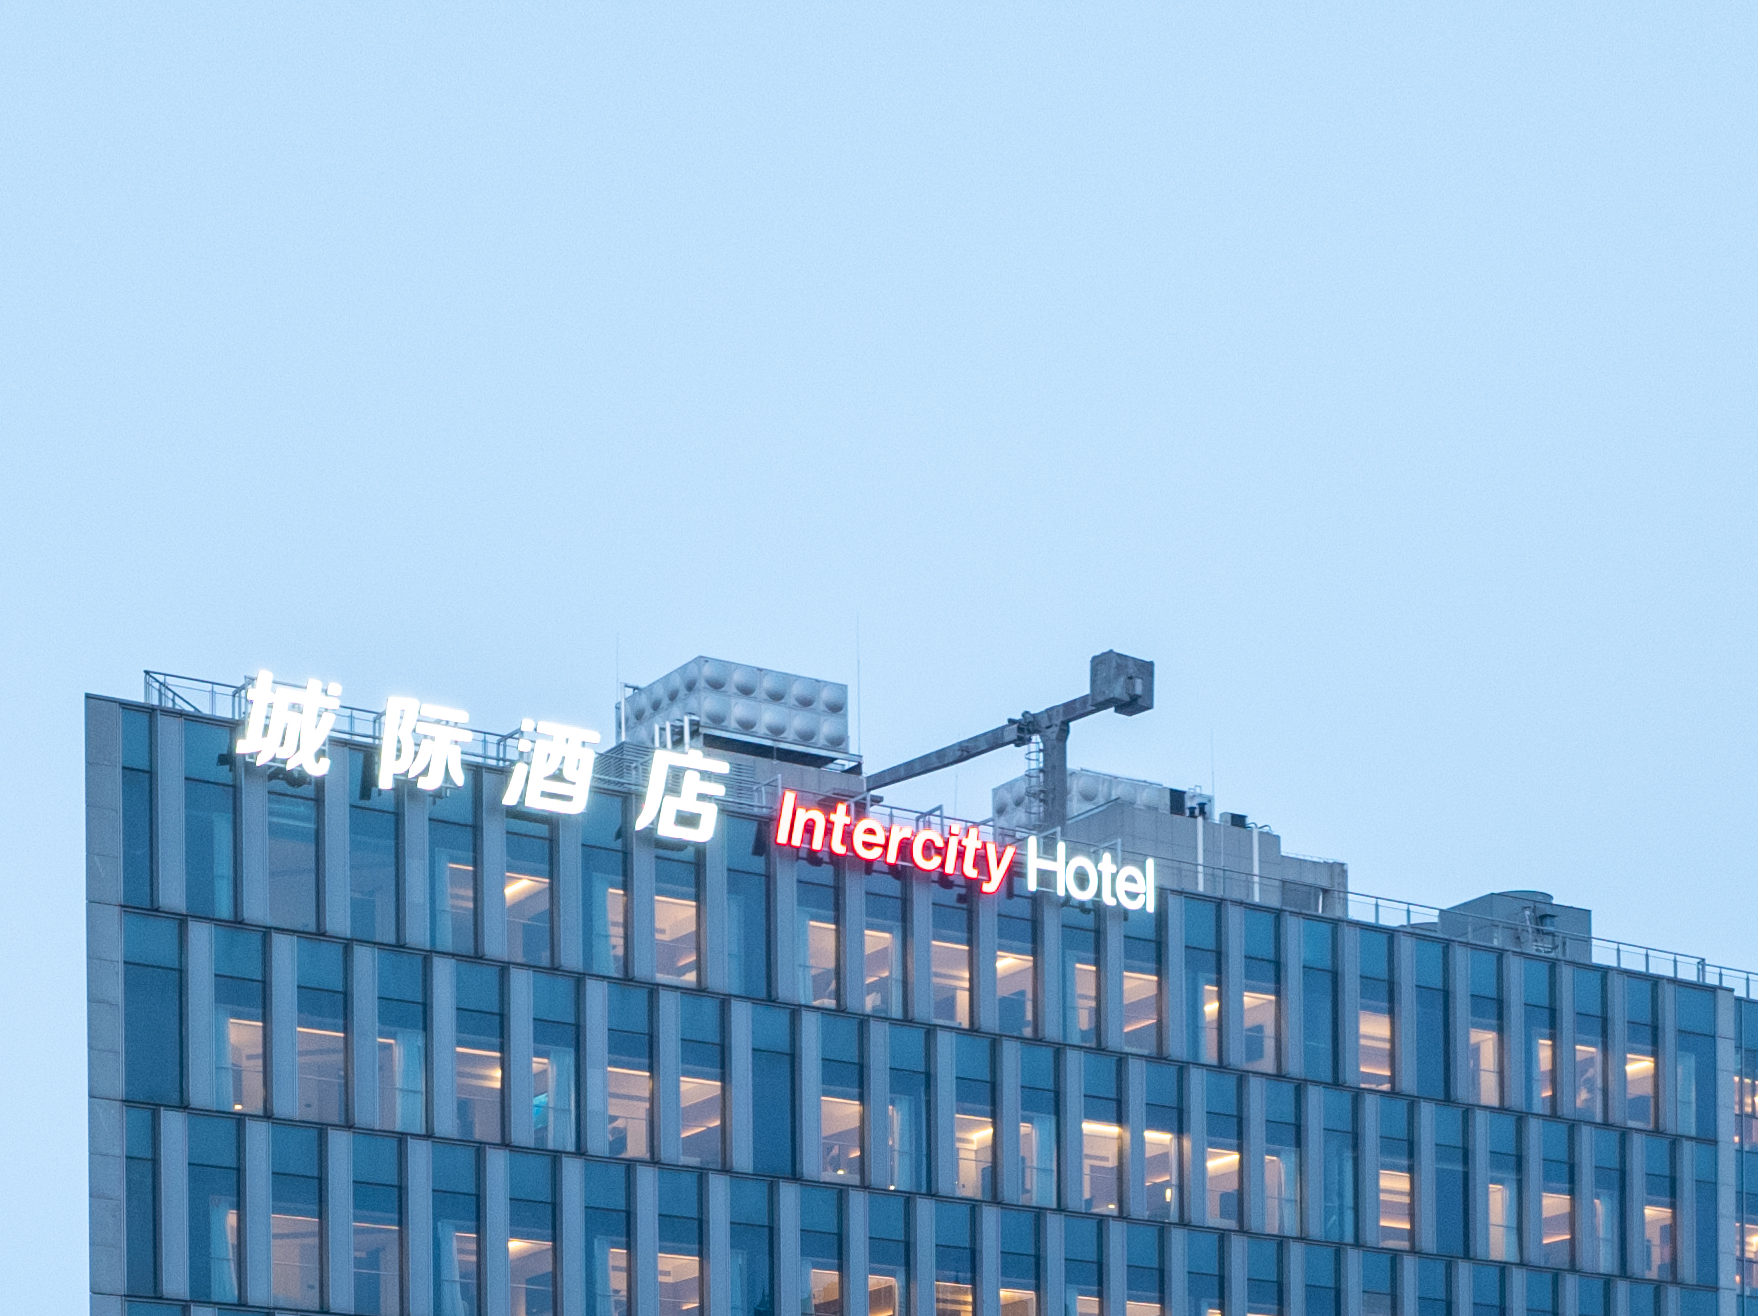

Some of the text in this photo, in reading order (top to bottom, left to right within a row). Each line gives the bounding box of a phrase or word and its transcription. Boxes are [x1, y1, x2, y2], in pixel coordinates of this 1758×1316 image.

[237, 670, 731, 843] 城际酒店
[775, 790, 1156, 914] Intercity Hotel
